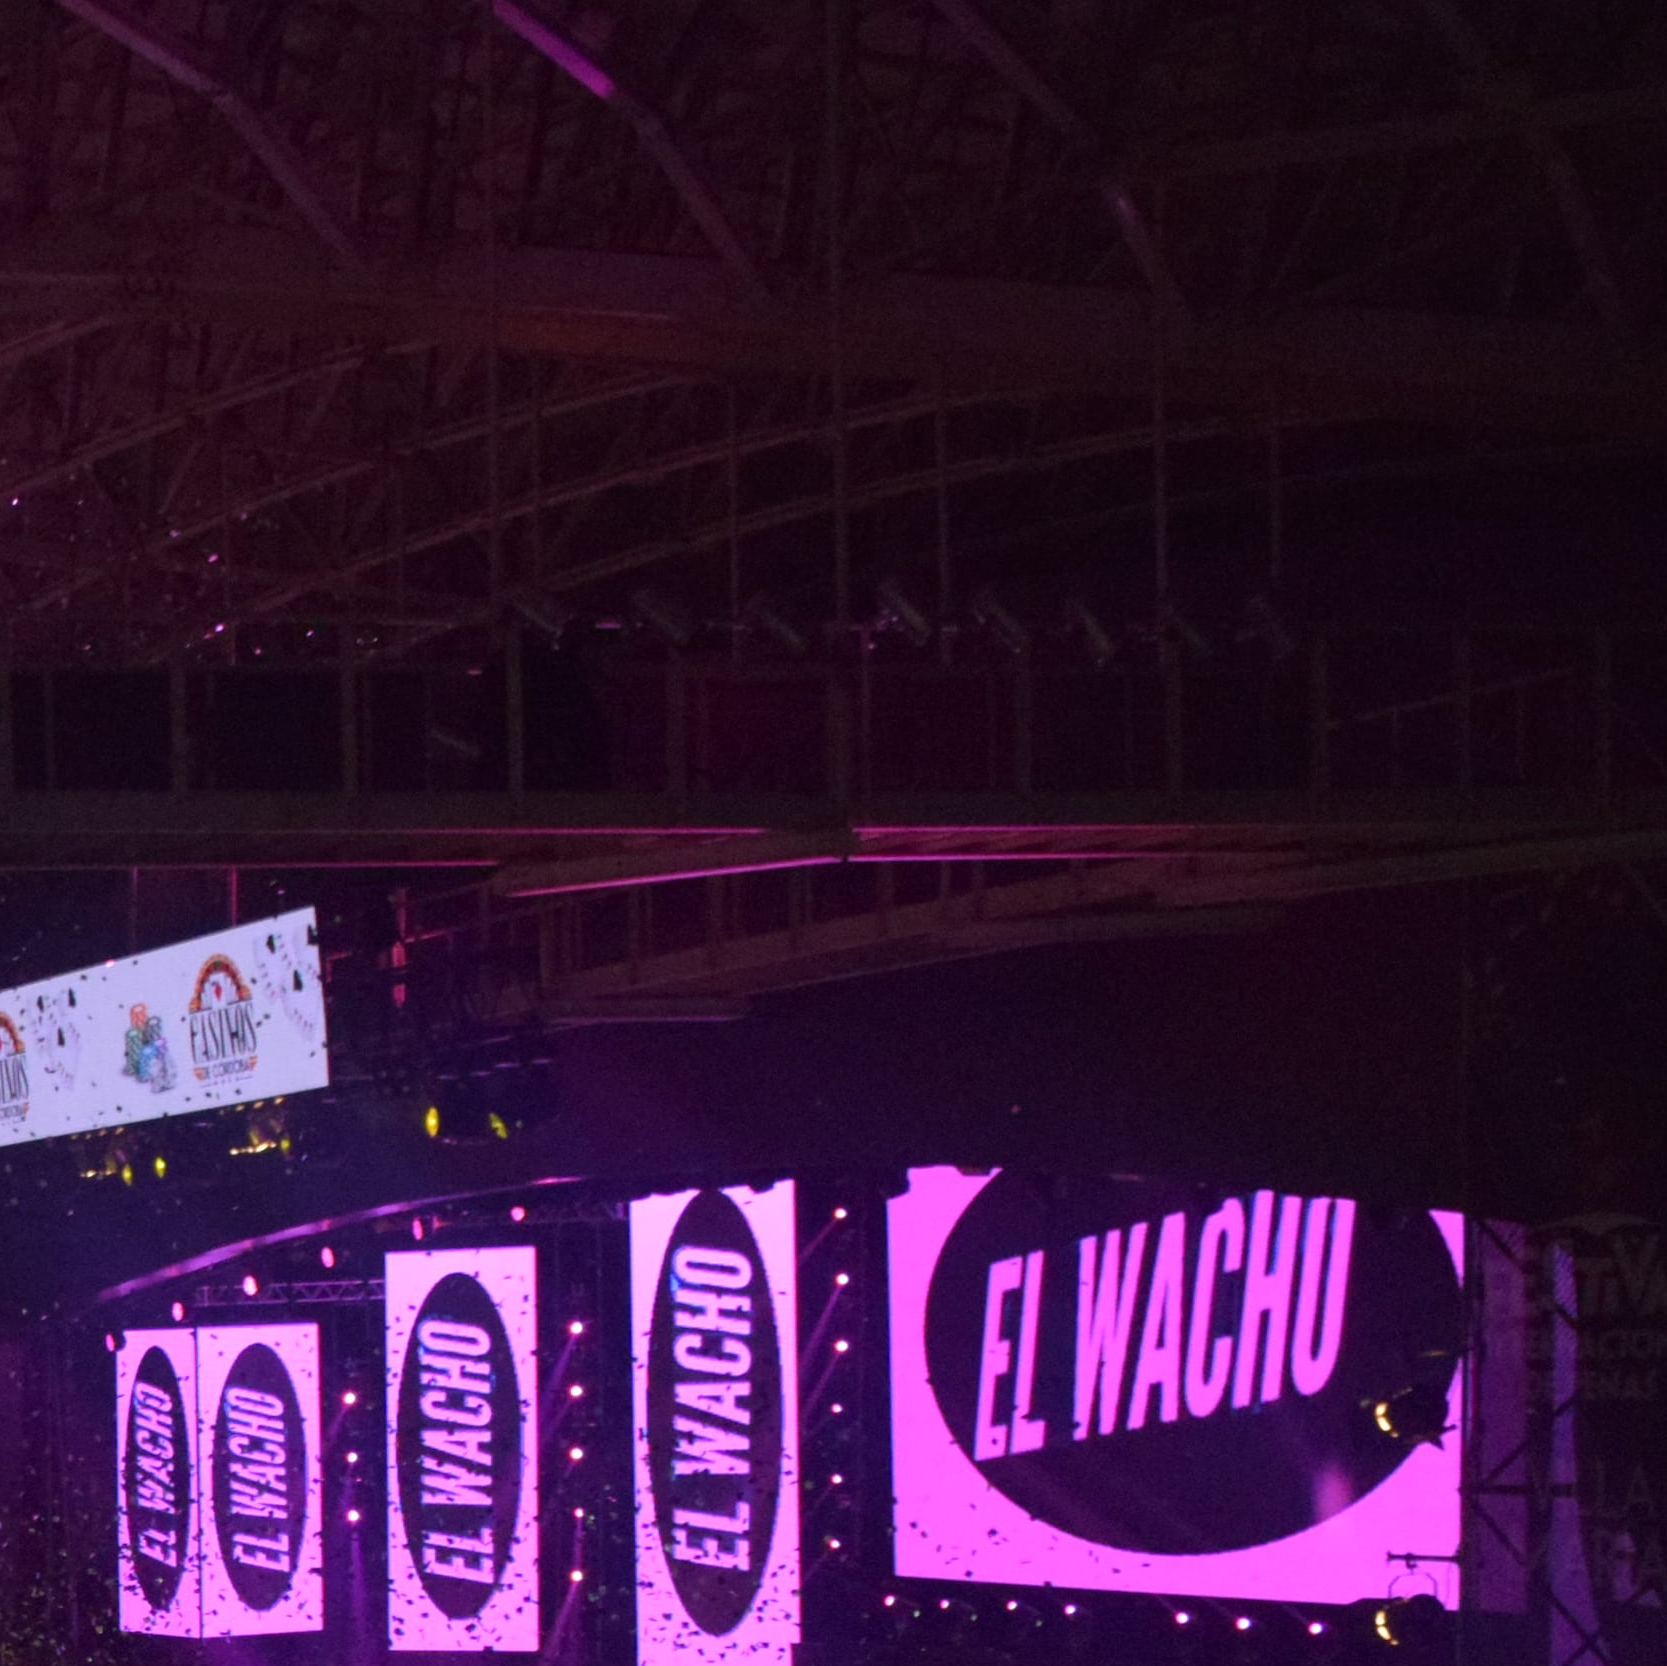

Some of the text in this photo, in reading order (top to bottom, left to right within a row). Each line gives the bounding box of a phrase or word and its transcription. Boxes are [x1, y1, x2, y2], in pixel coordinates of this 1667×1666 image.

[418, 1318, 494, 1584] EL WACHO
[671, 1245, 753, 1572] EL WACHO
[974, 1189, 1357, 1462] EL WACHO
[134, 1382, 178, 1568] EL WACHO
[224, 1387, 291, 1573] EL WACHO
